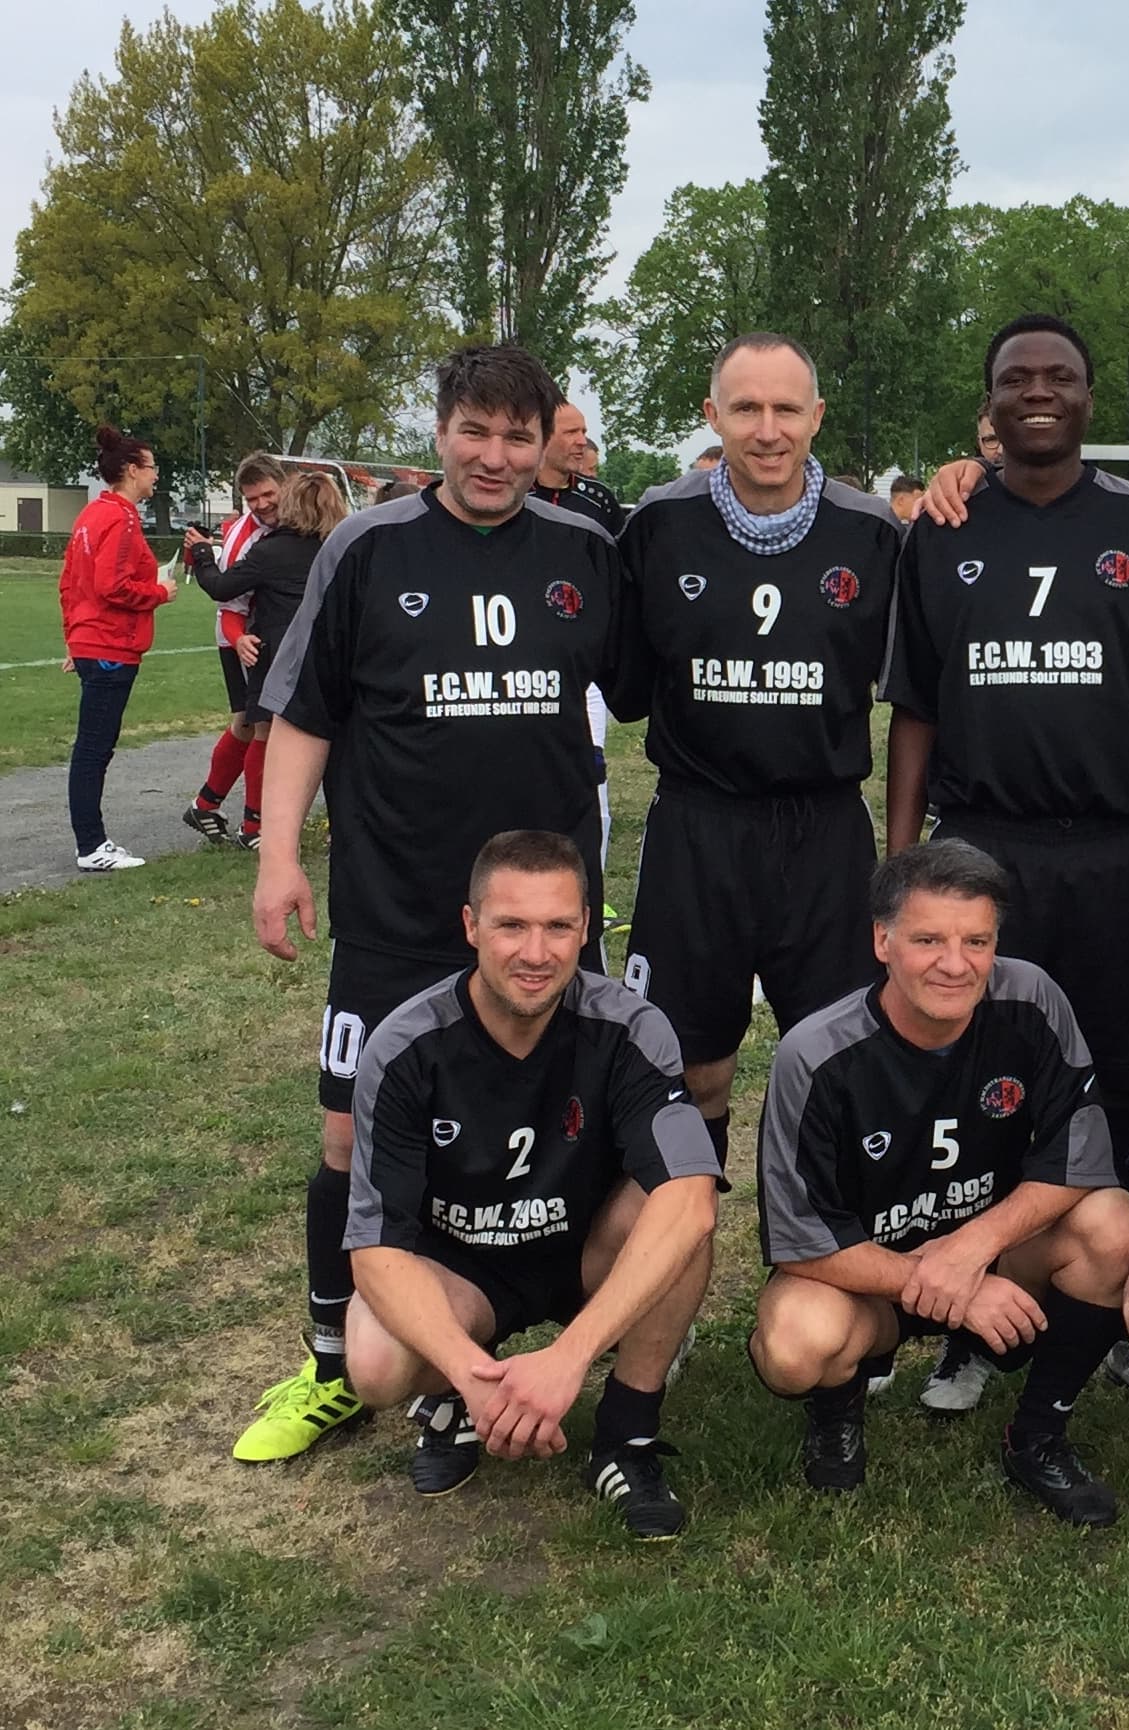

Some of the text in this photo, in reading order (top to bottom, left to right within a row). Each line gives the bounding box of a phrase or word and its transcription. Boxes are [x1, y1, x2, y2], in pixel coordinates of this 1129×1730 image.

[1028, 566, 1058, 617] 7
[472, 594, 516, 646] 10
[752, 583, 782, 636] 9
[968, 640, 1103, 670] F.C.W. 1993
[423, 670, 561, 702] F.C.W. 1993
[691, 658, 824, 690] F.C.W. 1993
[969, 672, 986, 686] ELF
[987, 671, 1029, 685] FREUNDE
[1030, 671, 1060, 685] SOLLT
[1080, 671, 1103, 685] SEIN
[426, 704, 444, 718] ELF
[444, 702, 492, 717] FREUNDE
[492, 702, 523, 716] SOLLT
[693, 688, 707, 701] ELF
[707, 689, 749, 704] FREUNDE
[749, 691, 780, 705] SOLLT
[505, 1126, 536, 1181] 2
[931, 1118, 960, 1170] 5
[943, 1171, 995, 1206] 993
[431, 1197, 504, 1230] F.C.W.
